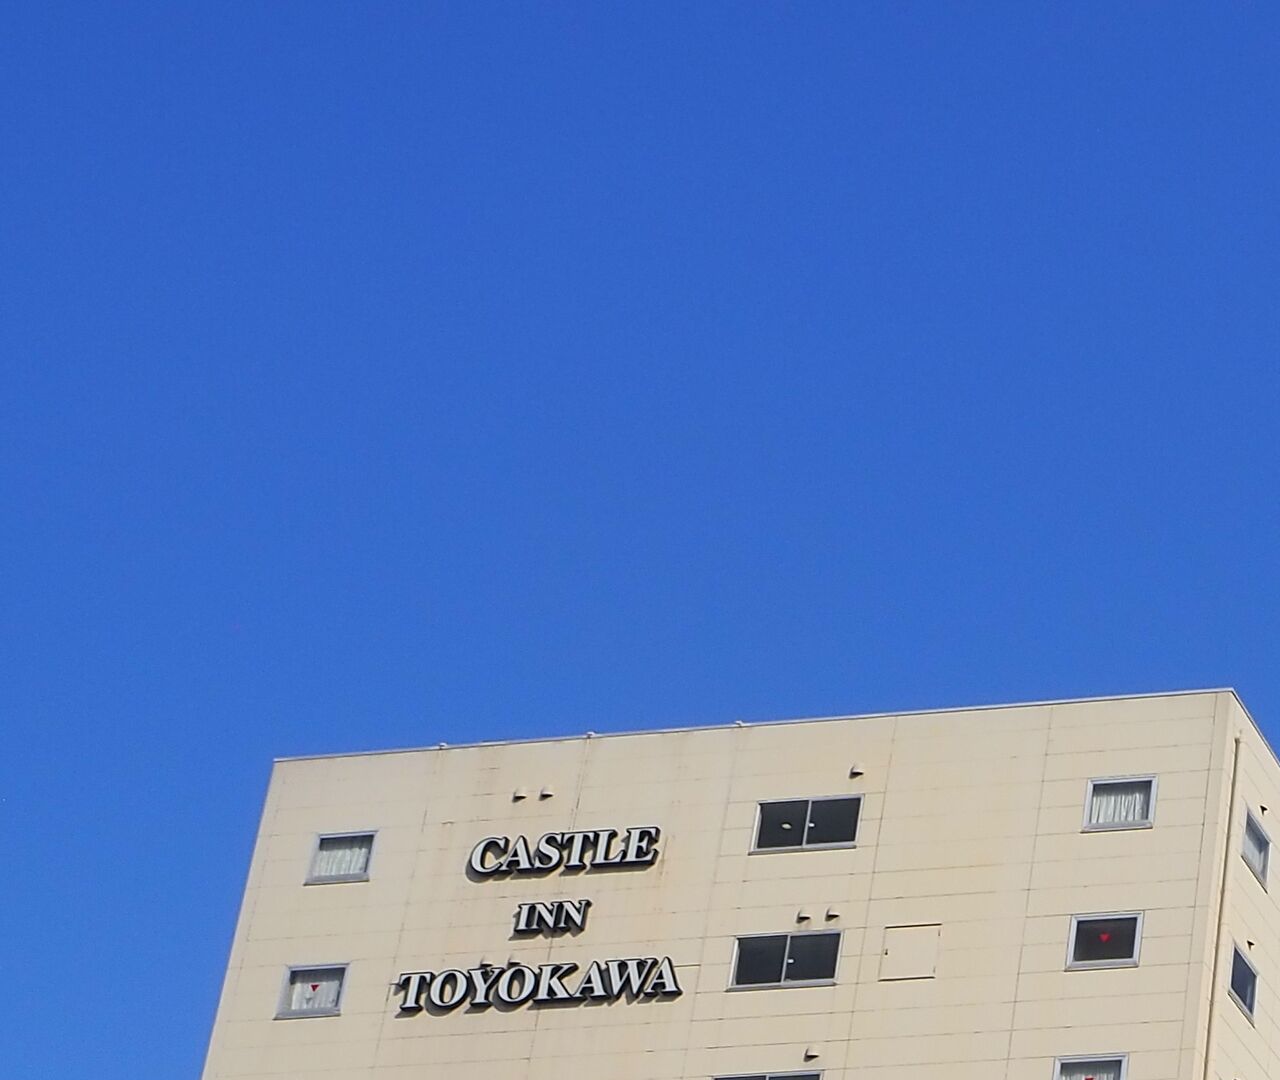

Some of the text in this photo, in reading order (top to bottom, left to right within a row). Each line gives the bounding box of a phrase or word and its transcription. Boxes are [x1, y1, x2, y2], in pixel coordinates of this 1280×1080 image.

[469, 825, 661, 876] CASTLE
[514, 899, 592, 933] INN
[399, 956, 683, 1011] TOYOKAWA
